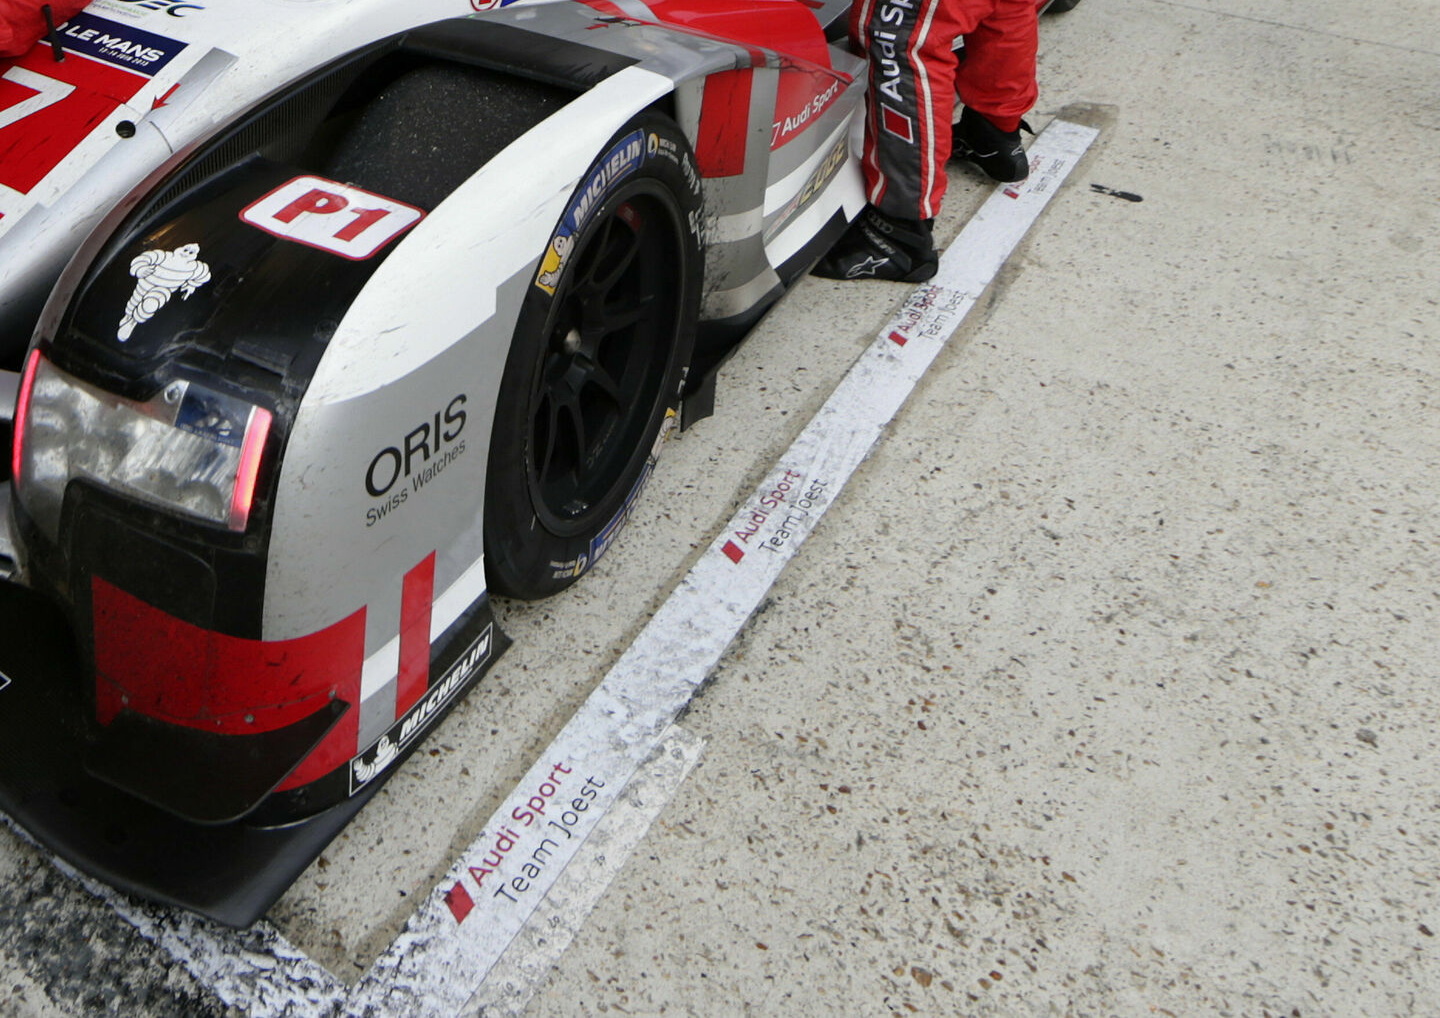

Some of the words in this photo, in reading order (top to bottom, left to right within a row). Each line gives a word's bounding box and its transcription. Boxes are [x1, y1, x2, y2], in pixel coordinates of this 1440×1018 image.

[64, 24, 100, 43] LE
[93, 33, 165, 63] MANS
[872, 31, 903, 103] Audi
[781, 103, 812, 136] Audi
[812, 79, 839, 114] Sport
[273, 189, 392, 243] P1
[573, 138, 643, 228] MICHELIN
[365, 393, 468, 498] ORIS
[365, 489, 409, 528] Swiss
[412, 439, 467, 493] Watches
[735, 501, 768, 543] Audi
[769, 467, 803, 507] Sport
[759, 519, 802, 556] Team
[789, 478, 829, 520] Joest
[397, 631, 491, 741] MICHELIN
[468, 823, 521, 888] Audi
[511, 760, 573, 828] Sport
[493, 837, 559, 905] Team
[548, 774, 605, 839] Joest
